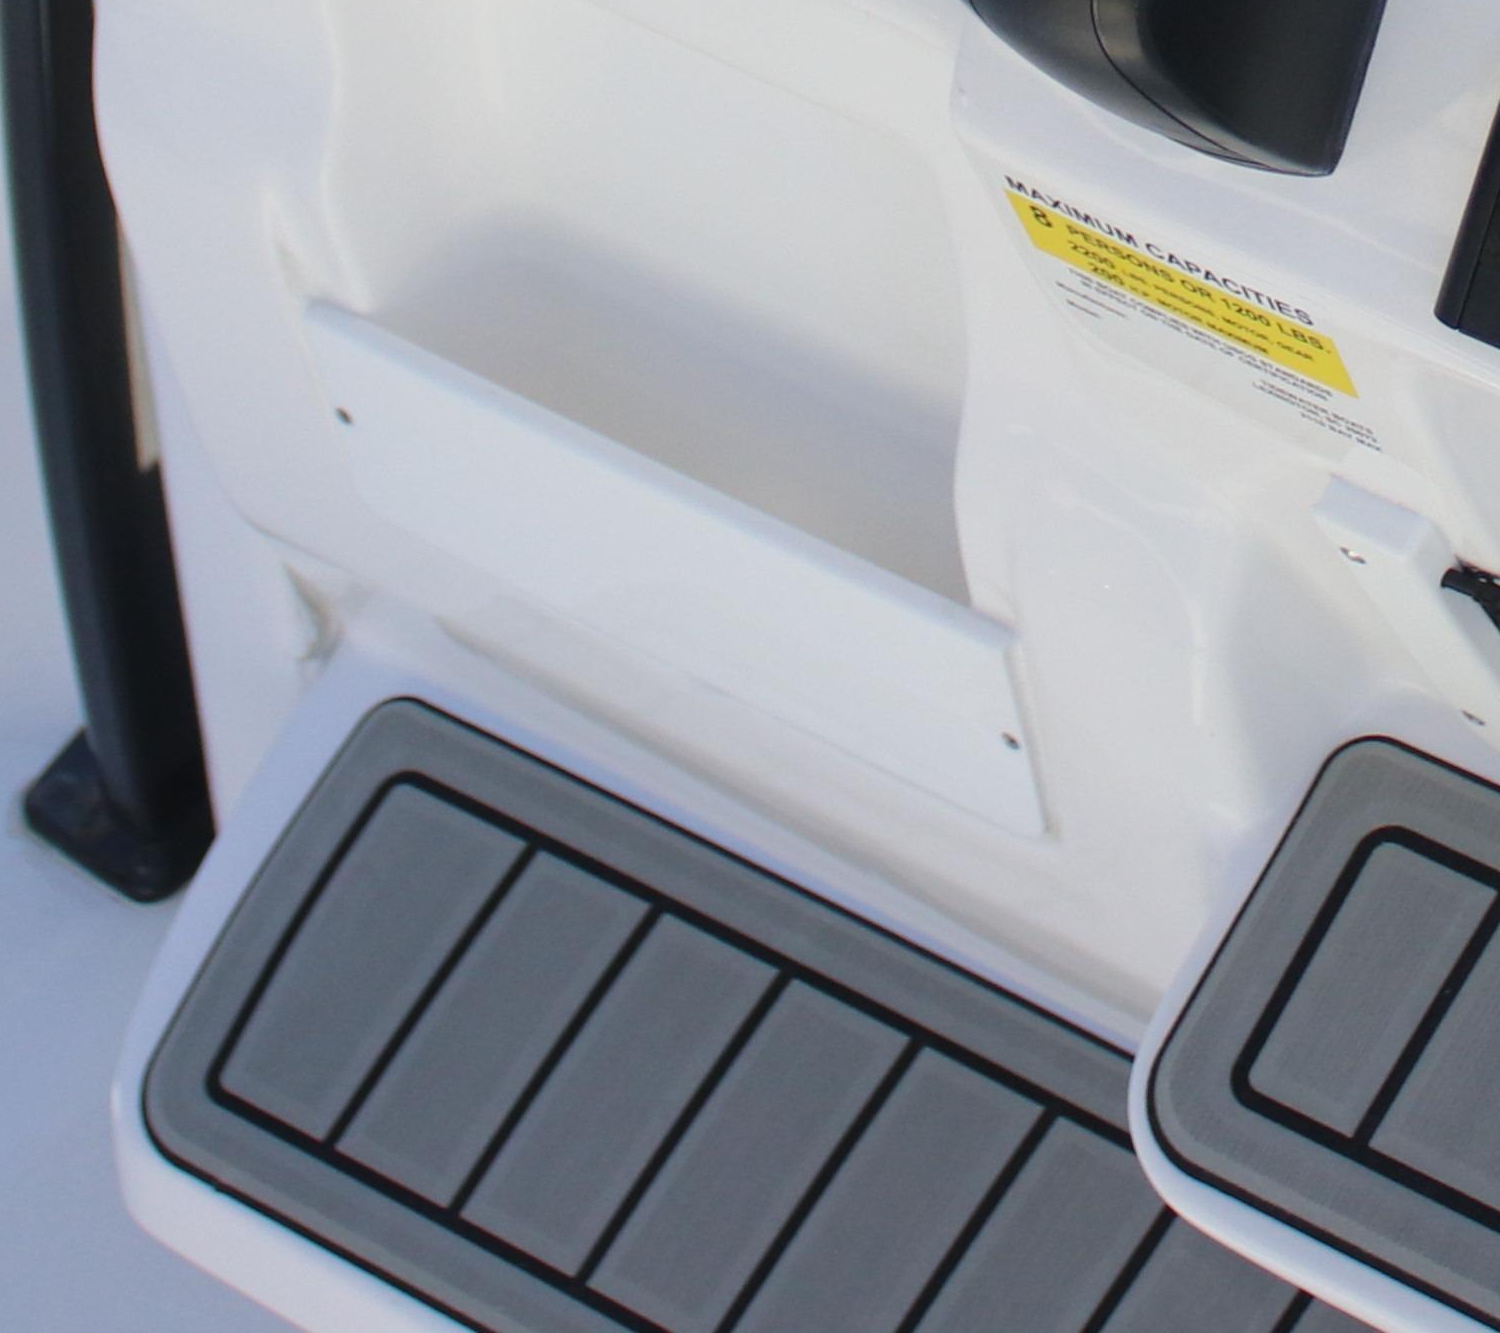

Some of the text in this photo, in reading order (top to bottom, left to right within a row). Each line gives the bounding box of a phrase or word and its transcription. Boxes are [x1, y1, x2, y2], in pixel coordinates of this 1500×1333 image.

[1004, 174, 1139, 248] MAXIMUM
[1145, 242, 1314, 326] CAPACITIES
[1066, 224, 1175, 283] PERSONS
[1180, 279, 1216, 303] OR
[1221, 297, 1271, 327] 1200
